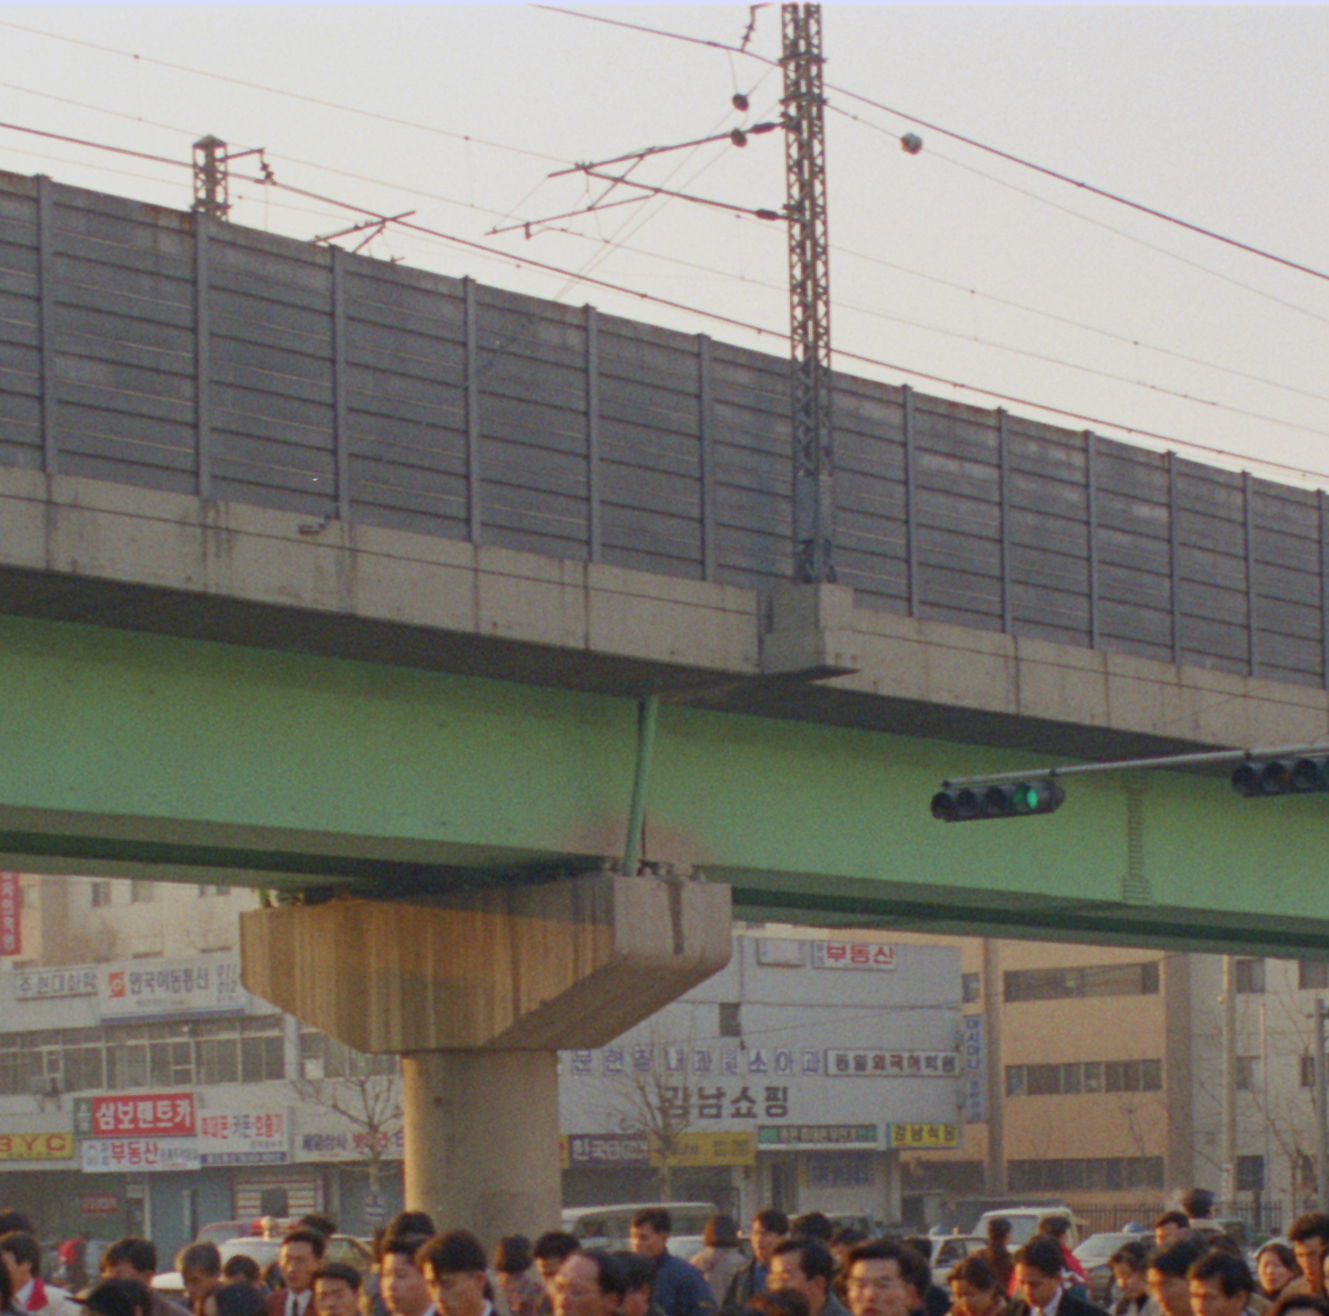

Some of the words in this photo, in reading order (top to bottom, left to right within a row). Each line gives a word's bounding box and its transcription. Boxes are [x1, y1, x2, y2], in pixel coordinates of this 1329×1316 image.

[826, 943, 895, 965] 부동산
[96, 1099, 193, 1131] 삼보렌트카
[663, 1086, 789, 1119] 강남쇼핑
[110, 1141, 160, 1165] 부동산
